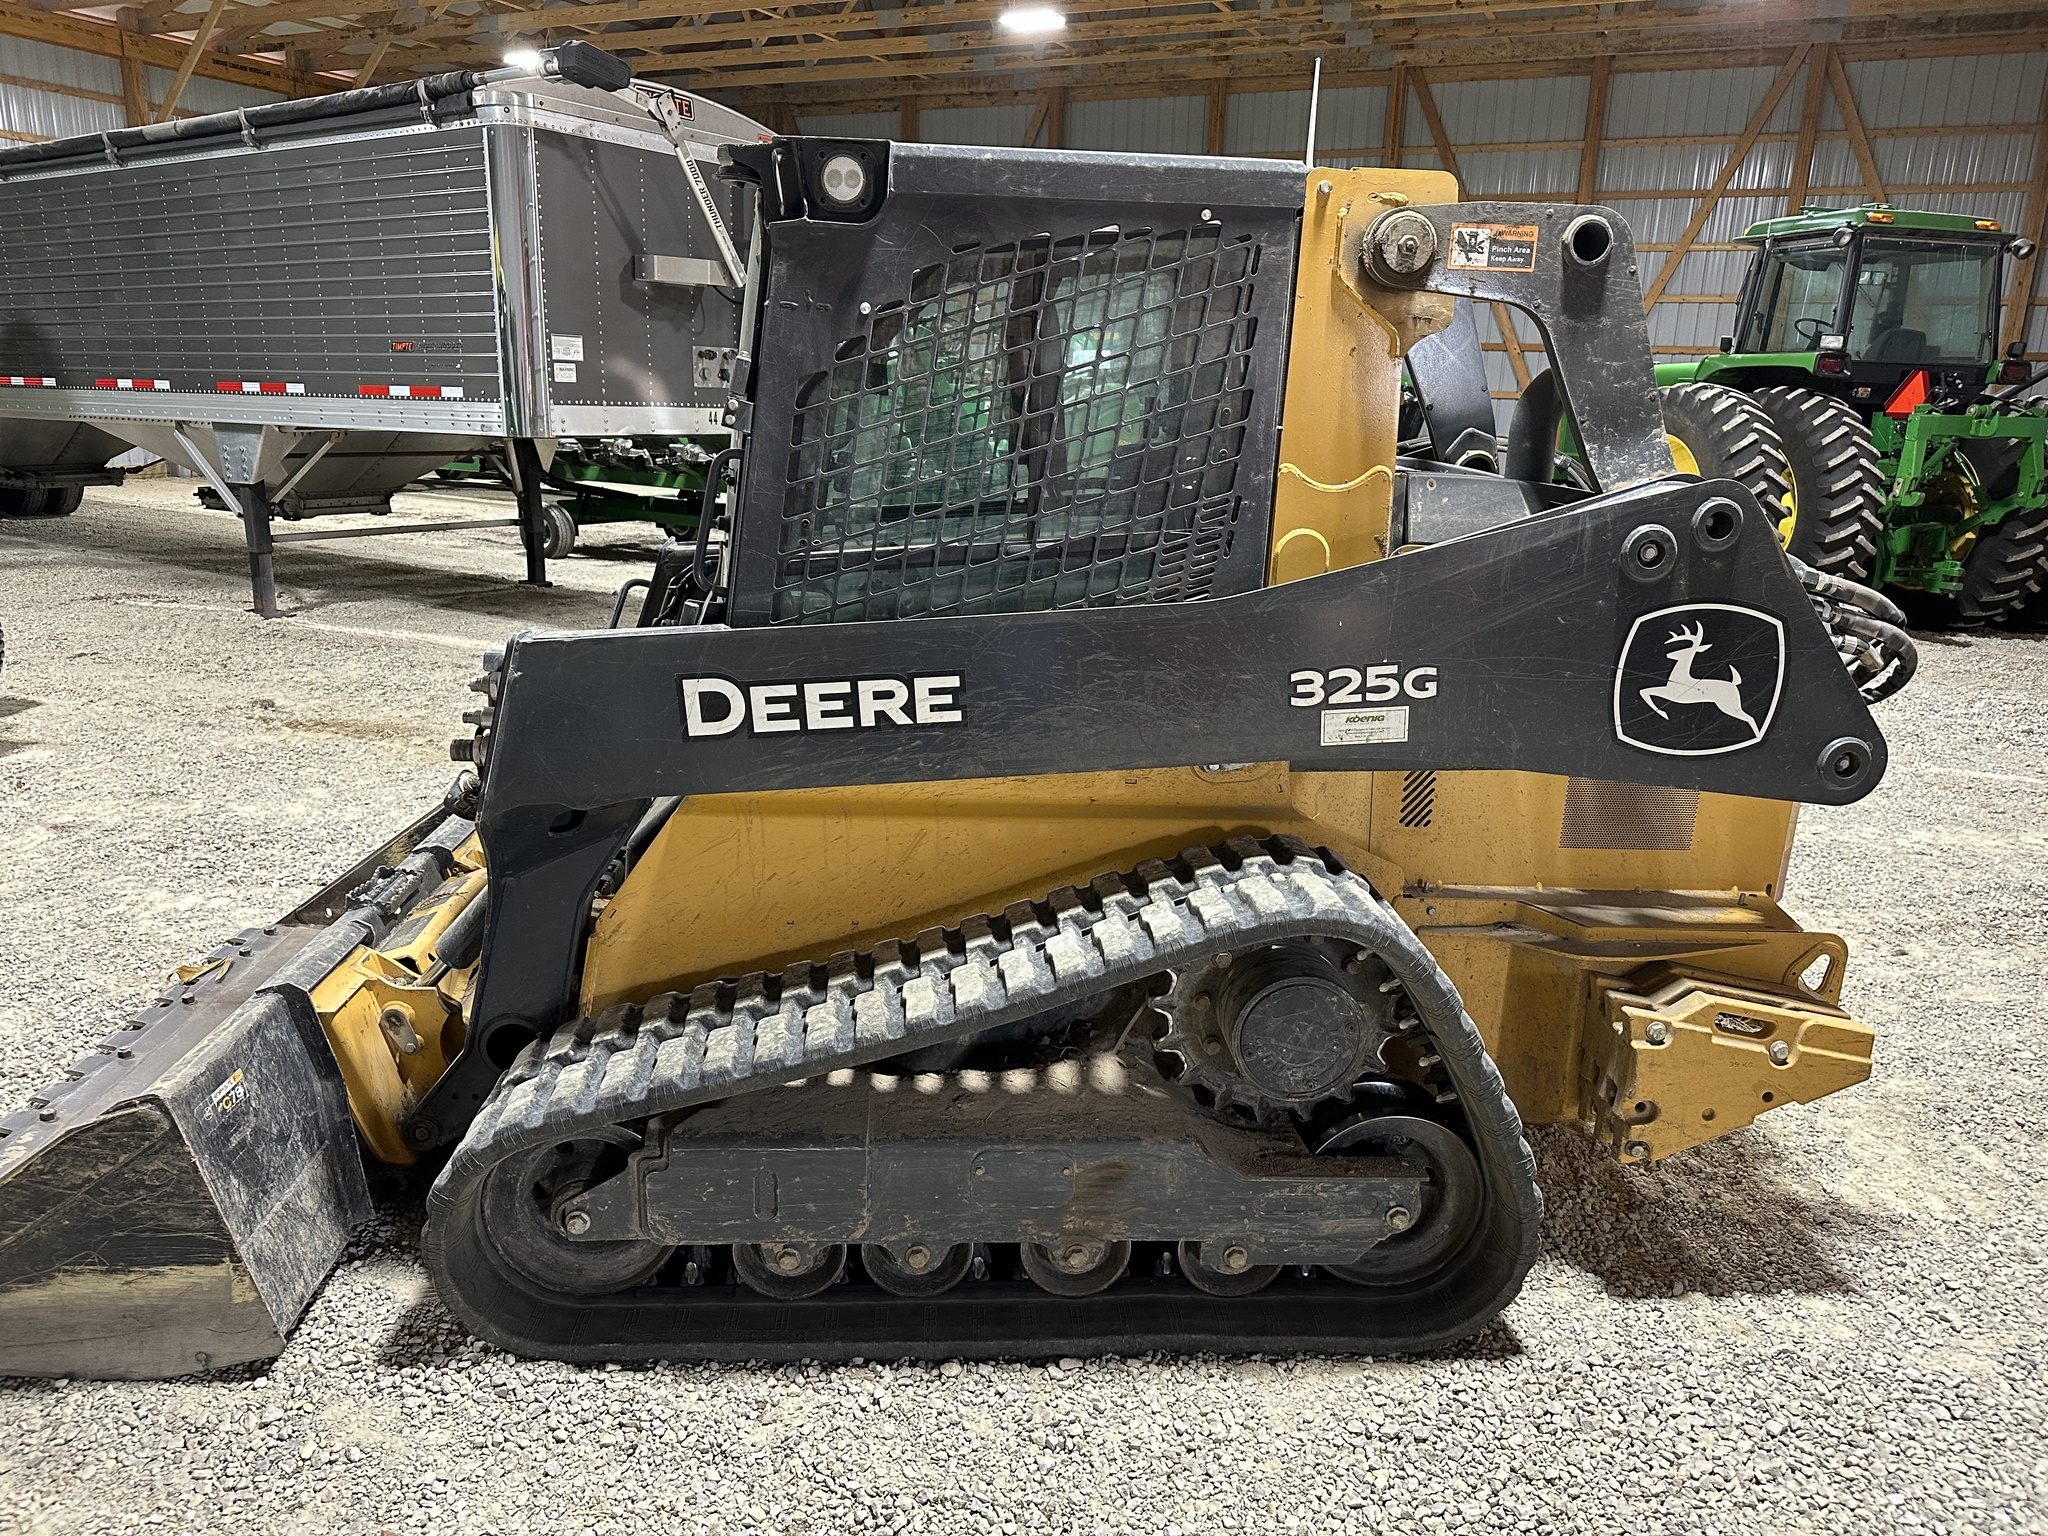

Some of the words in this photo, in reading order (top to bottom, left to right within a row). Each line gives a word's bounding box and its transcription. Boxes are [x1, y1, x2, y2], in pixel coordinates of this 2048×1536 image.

[686, 159, 702, 186] 7000
[698, 187, 722, 229] THUNDER
[1501, 230, 1535, 238] WARNING
[1491, 245, 1512, 254] Pinch
[1513, 246, 1531, 254] Area
[1490, 255, 1507, 263] Keep
[392, 342, 413, 351] TIMPTE
[708, 411, 718, 425] 44
[1290, 664, 1438, 707] 325G
[682, 675, 963, 737] DEERE
